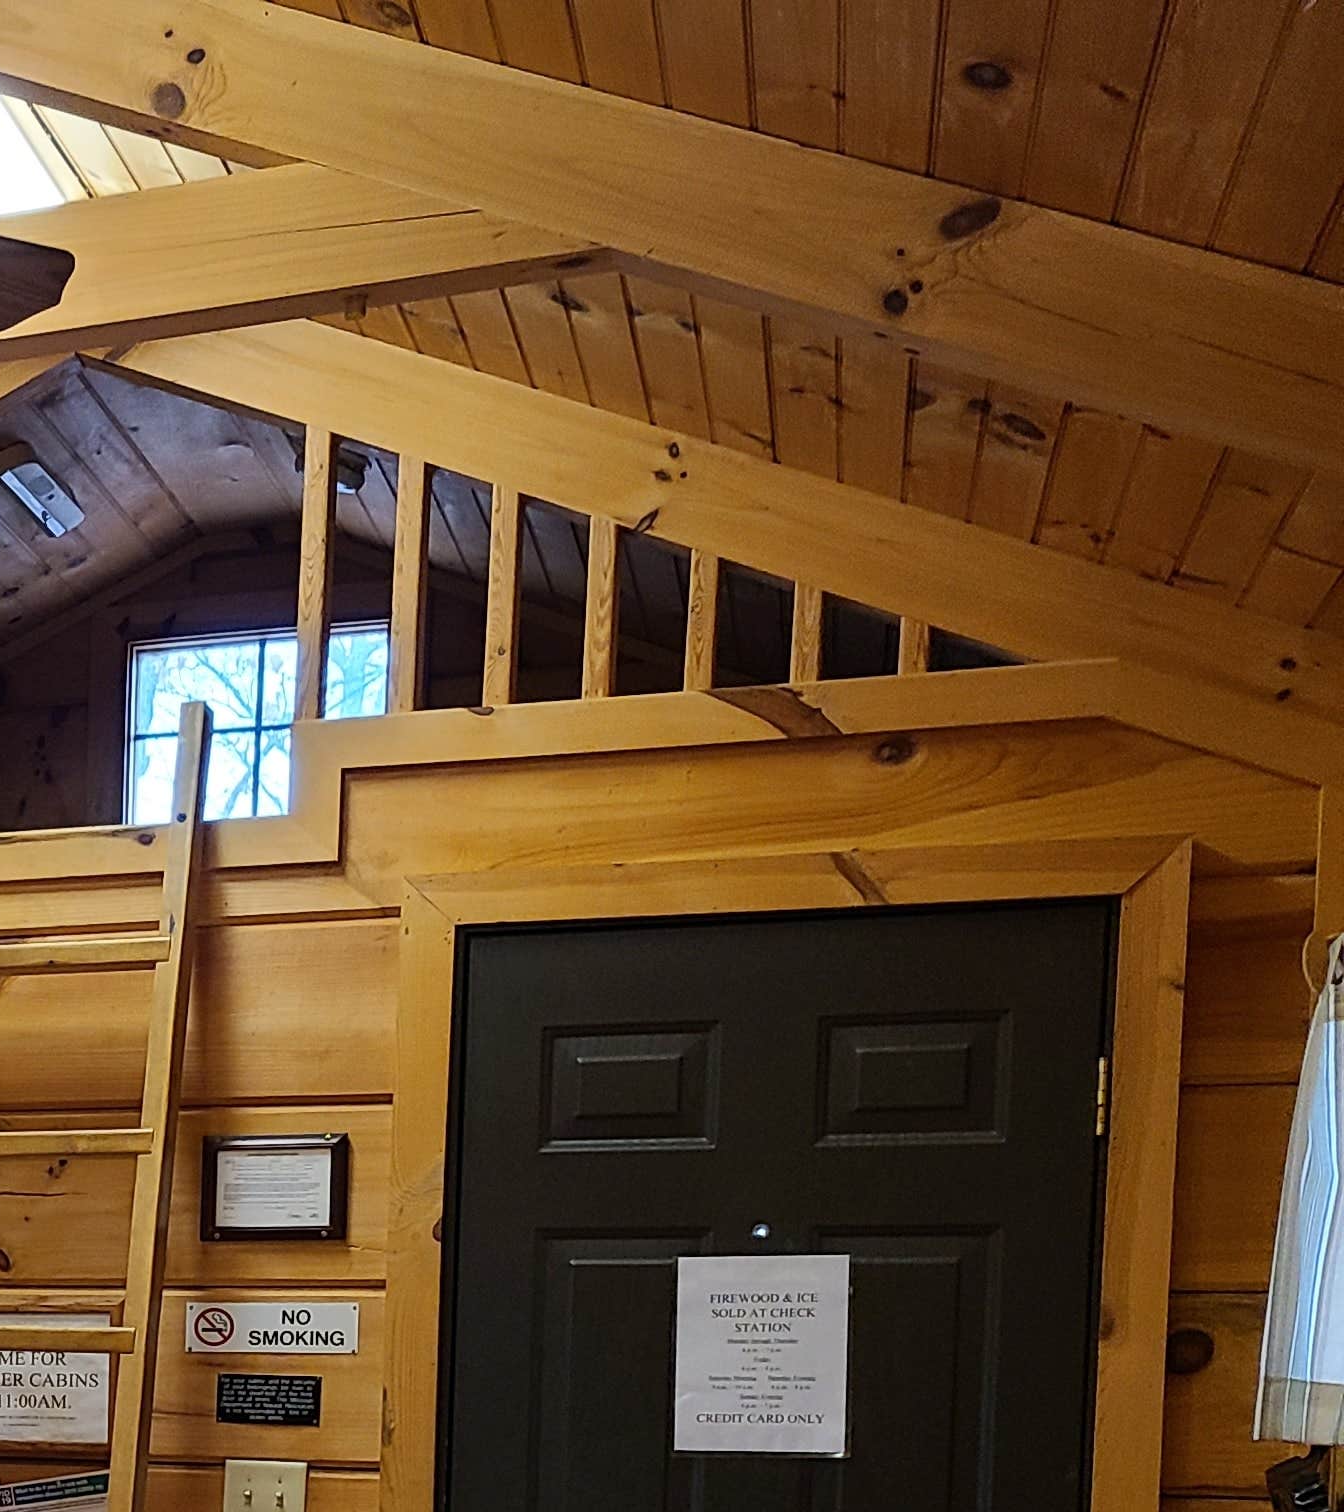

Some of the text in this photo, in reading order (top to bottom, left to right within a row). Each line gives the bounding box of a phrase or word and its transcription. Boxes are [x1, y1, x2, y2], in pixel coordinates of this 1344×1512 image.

[709, 1293, 818, 1304] FIREWOOD & ICE
[281, 1309, 312, 1326] NO
[711, 1307, 816, 1319] SOLD AT CHECK
[734, 1322, 791, 1333] STATION
[248, 1330, 345, 1347] SMOKING
[31, 1352, 67, 1366] FOR
[29, 1372, 99, 1388] CABINS
[696, 1413, 825, 1425] CREDIT CARD ONLY
